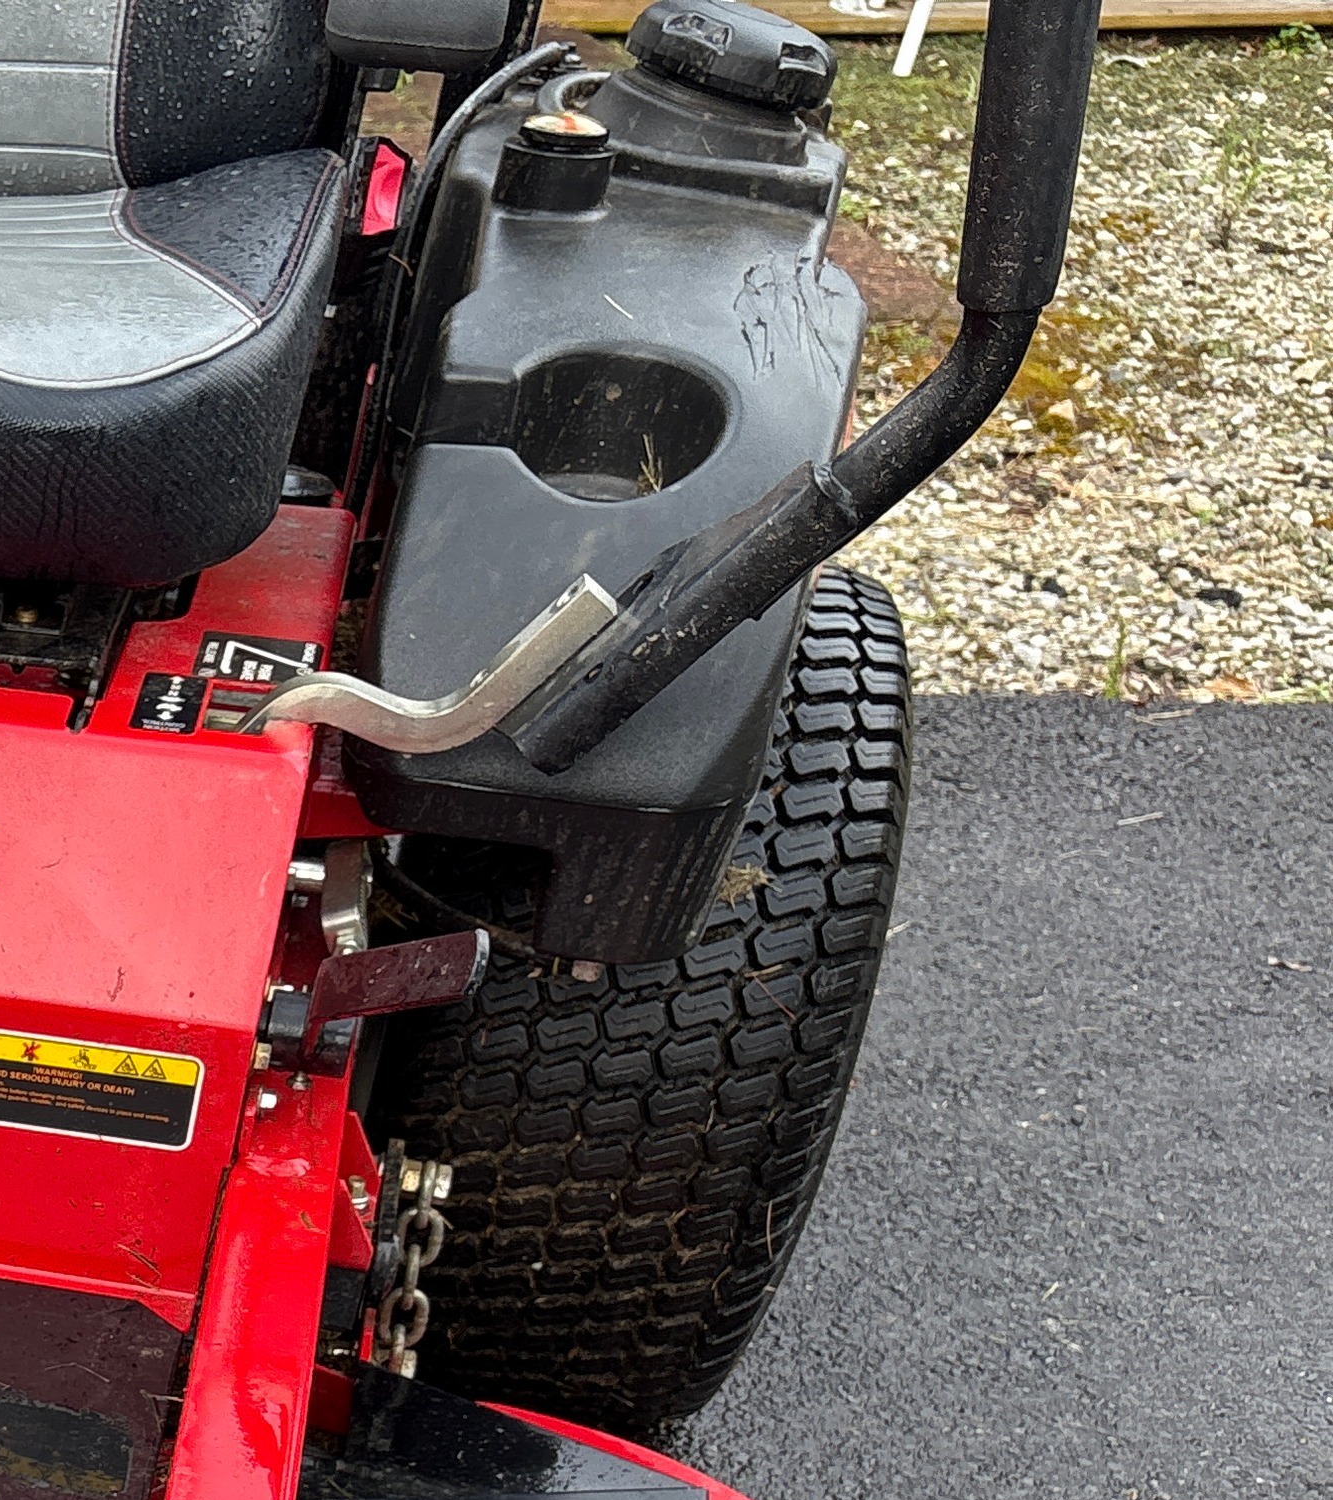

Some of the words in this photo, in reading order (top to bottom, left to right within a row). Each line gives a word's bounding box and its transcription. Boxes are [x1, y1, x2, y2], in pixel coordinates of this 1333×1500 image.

[9, 1072, 49, 1083] SERIOUS
[52, 1078, 85, 1088] INJURY
[87, 1082, 100, 1090] OR
[103, 1085, 135, 1095] DEATH
